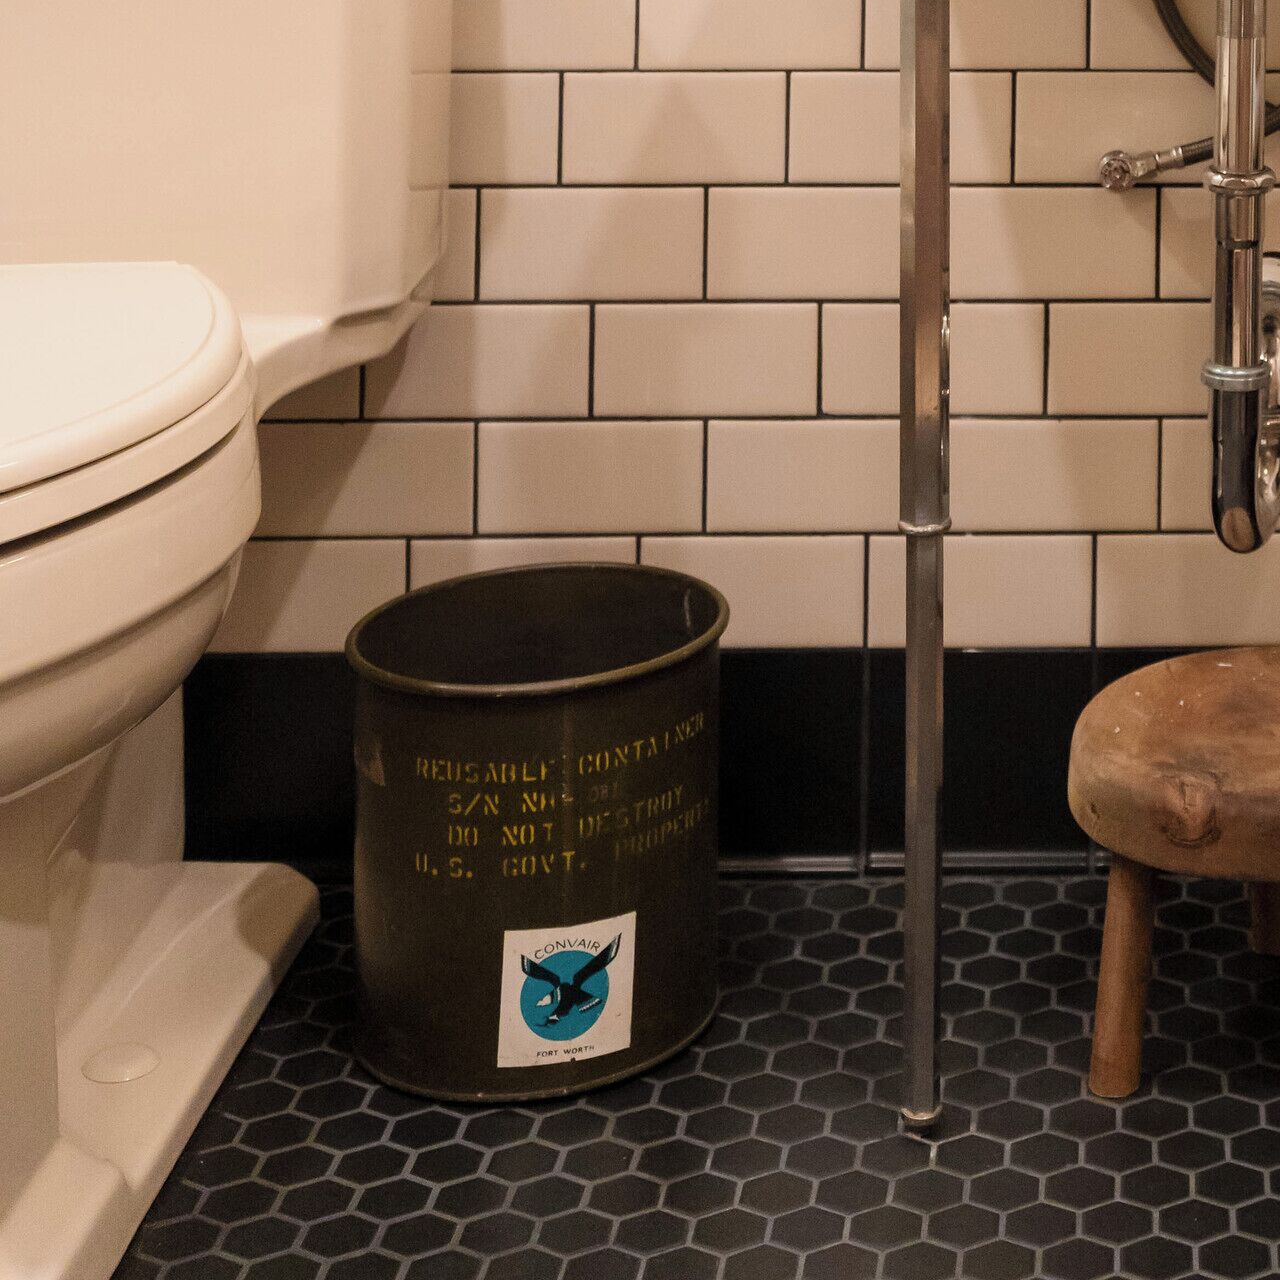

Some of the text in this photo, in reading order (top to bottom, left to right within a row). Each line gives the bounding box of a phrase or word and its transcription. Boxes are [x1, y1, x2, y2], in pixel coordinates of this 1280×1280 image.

[416, 712, 704, 784] REUSABLE CONTAINER
[449, 792, 500, 815] S/N
[449, 786, 683, 846] DO NOT DESTROY
[534, 939, 601, 960] CONVAIR
[536, 1045, 595, 1058] FORT WORTH
